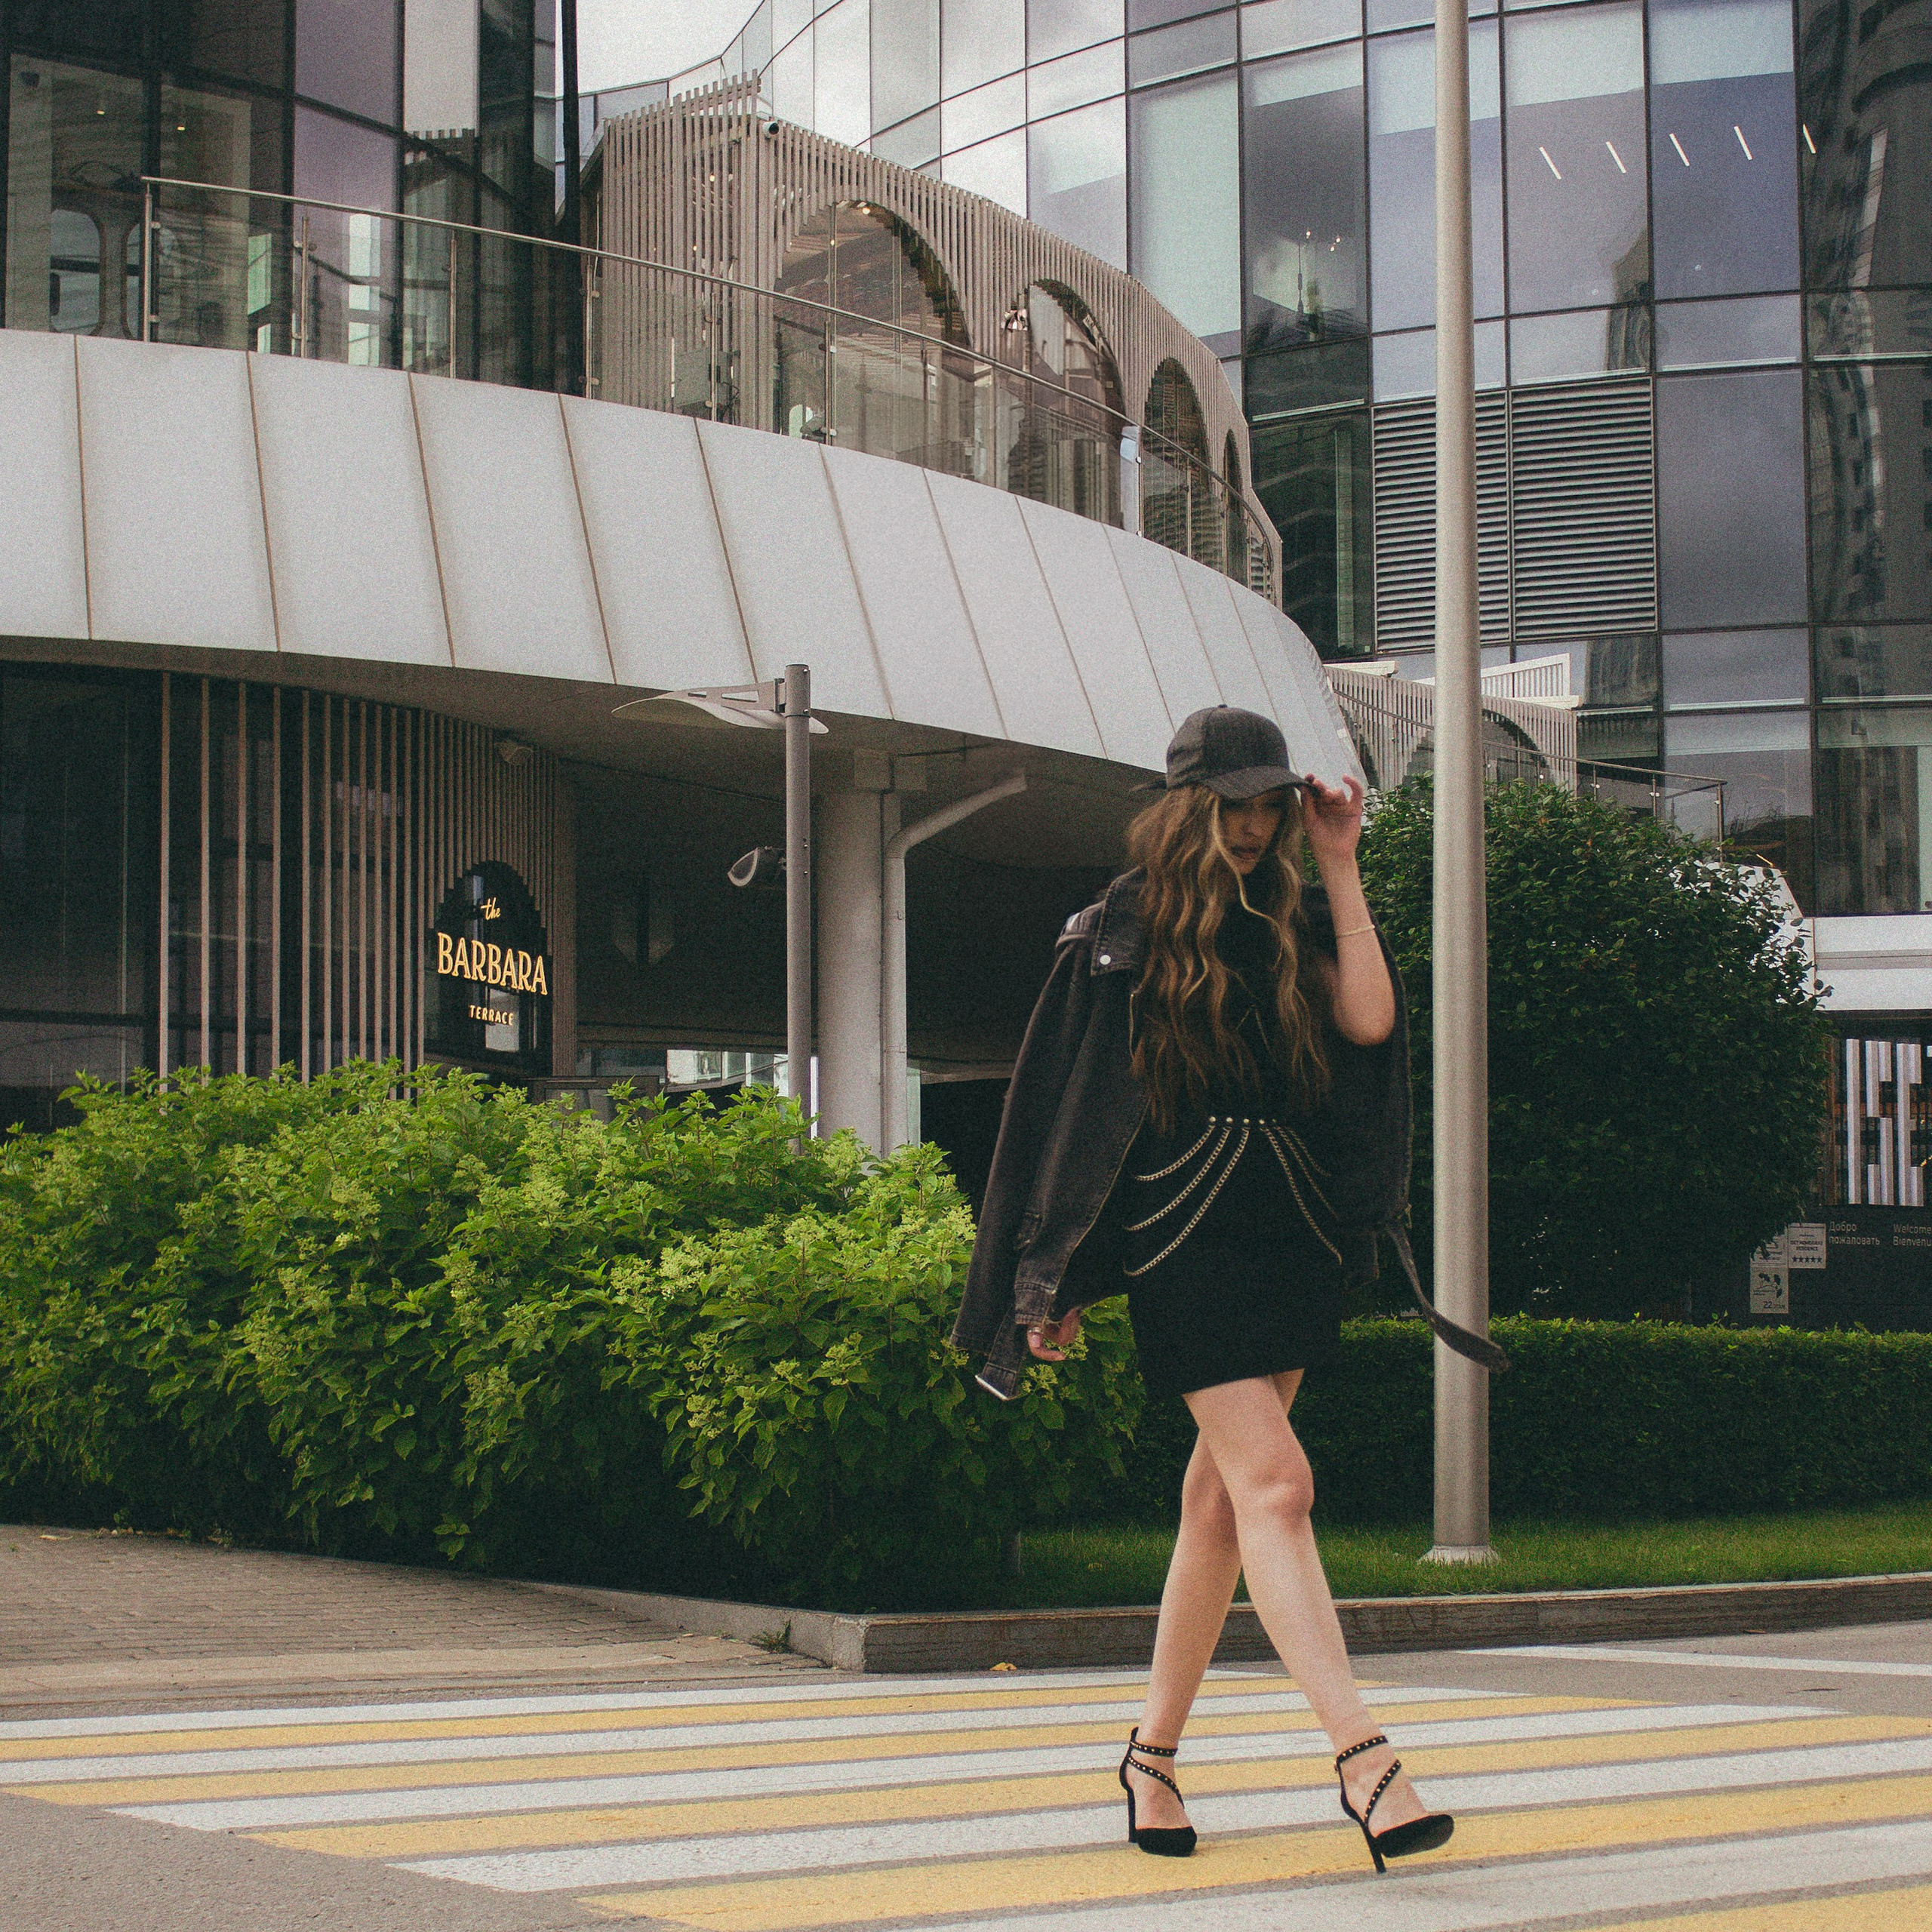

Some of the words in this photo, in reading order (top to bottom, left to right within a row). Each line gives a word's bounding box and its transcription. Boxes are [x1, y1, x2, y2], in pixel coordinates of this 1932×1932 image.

[481, 897, 500, 920] the
[437, 931, 548, 995] BARBARA
[469, 1004, 514, 1026] TERRACE
[1846, 1038, 1932, 1207] ISE
[1829, 1220, 1857, 1234] Добро
[1893, 1223, 1932, 1235] Welcome
[1829, 1236, 1881, 1245] пожаловать
